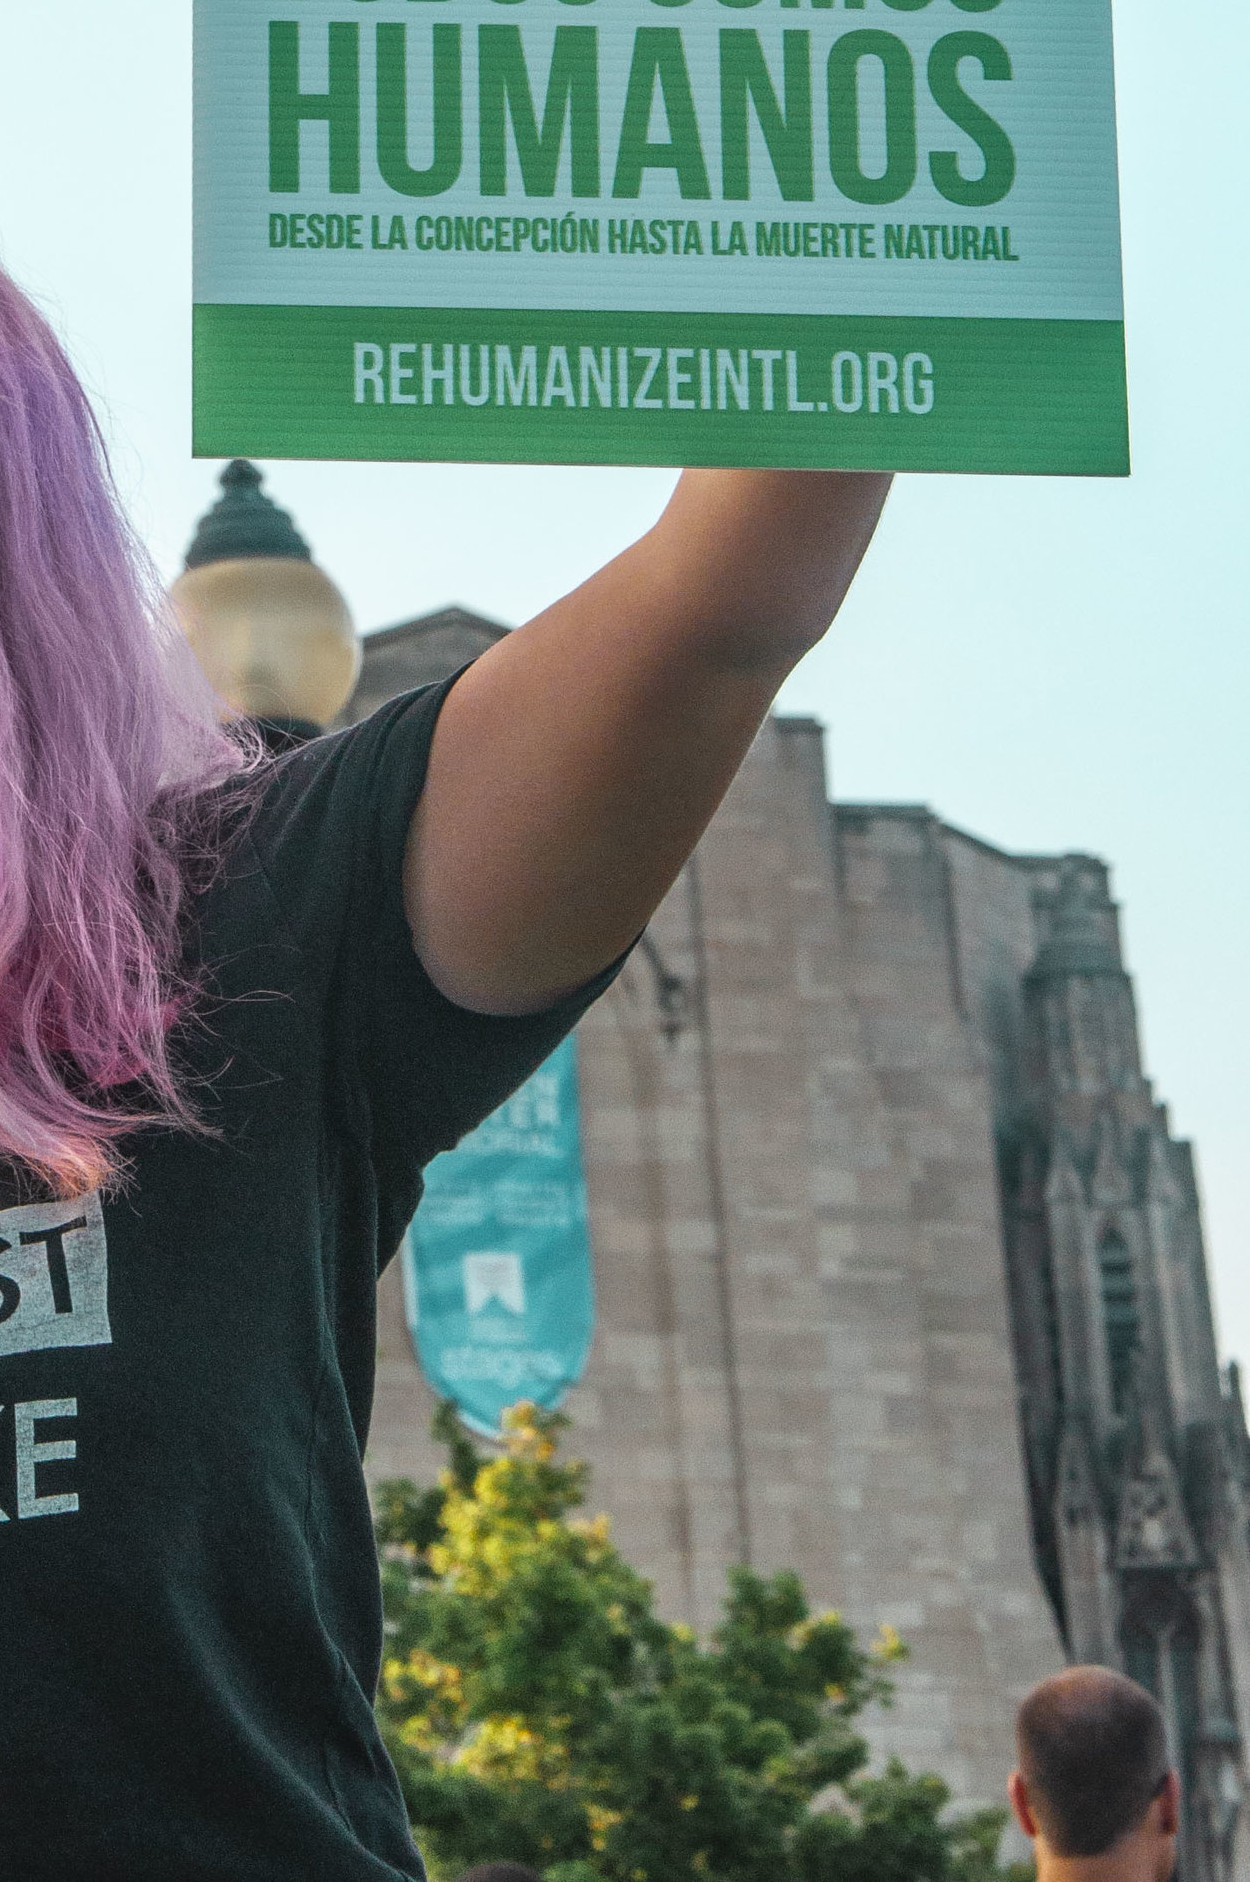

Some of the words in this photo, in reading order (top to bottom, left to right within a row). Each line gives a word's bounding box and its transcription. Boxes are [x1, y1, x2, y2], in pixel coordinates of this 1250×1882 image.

[267, 21, 1017, 207] HUMANOS
[268, 213, 364, 250] DESDE
[371, 214, 409, 251] LA
[415, 211, 599, 254] CONCEPCIÓN
[607, 218, 704, 255] HASTA
[711, 220, 750, 256] LA
[755, 221, 877, 259] MUERTE
[883, 224, 1021, 262] NATURAL
[352, 342, 935, 416] REHUMANIZEINTL.ORG
